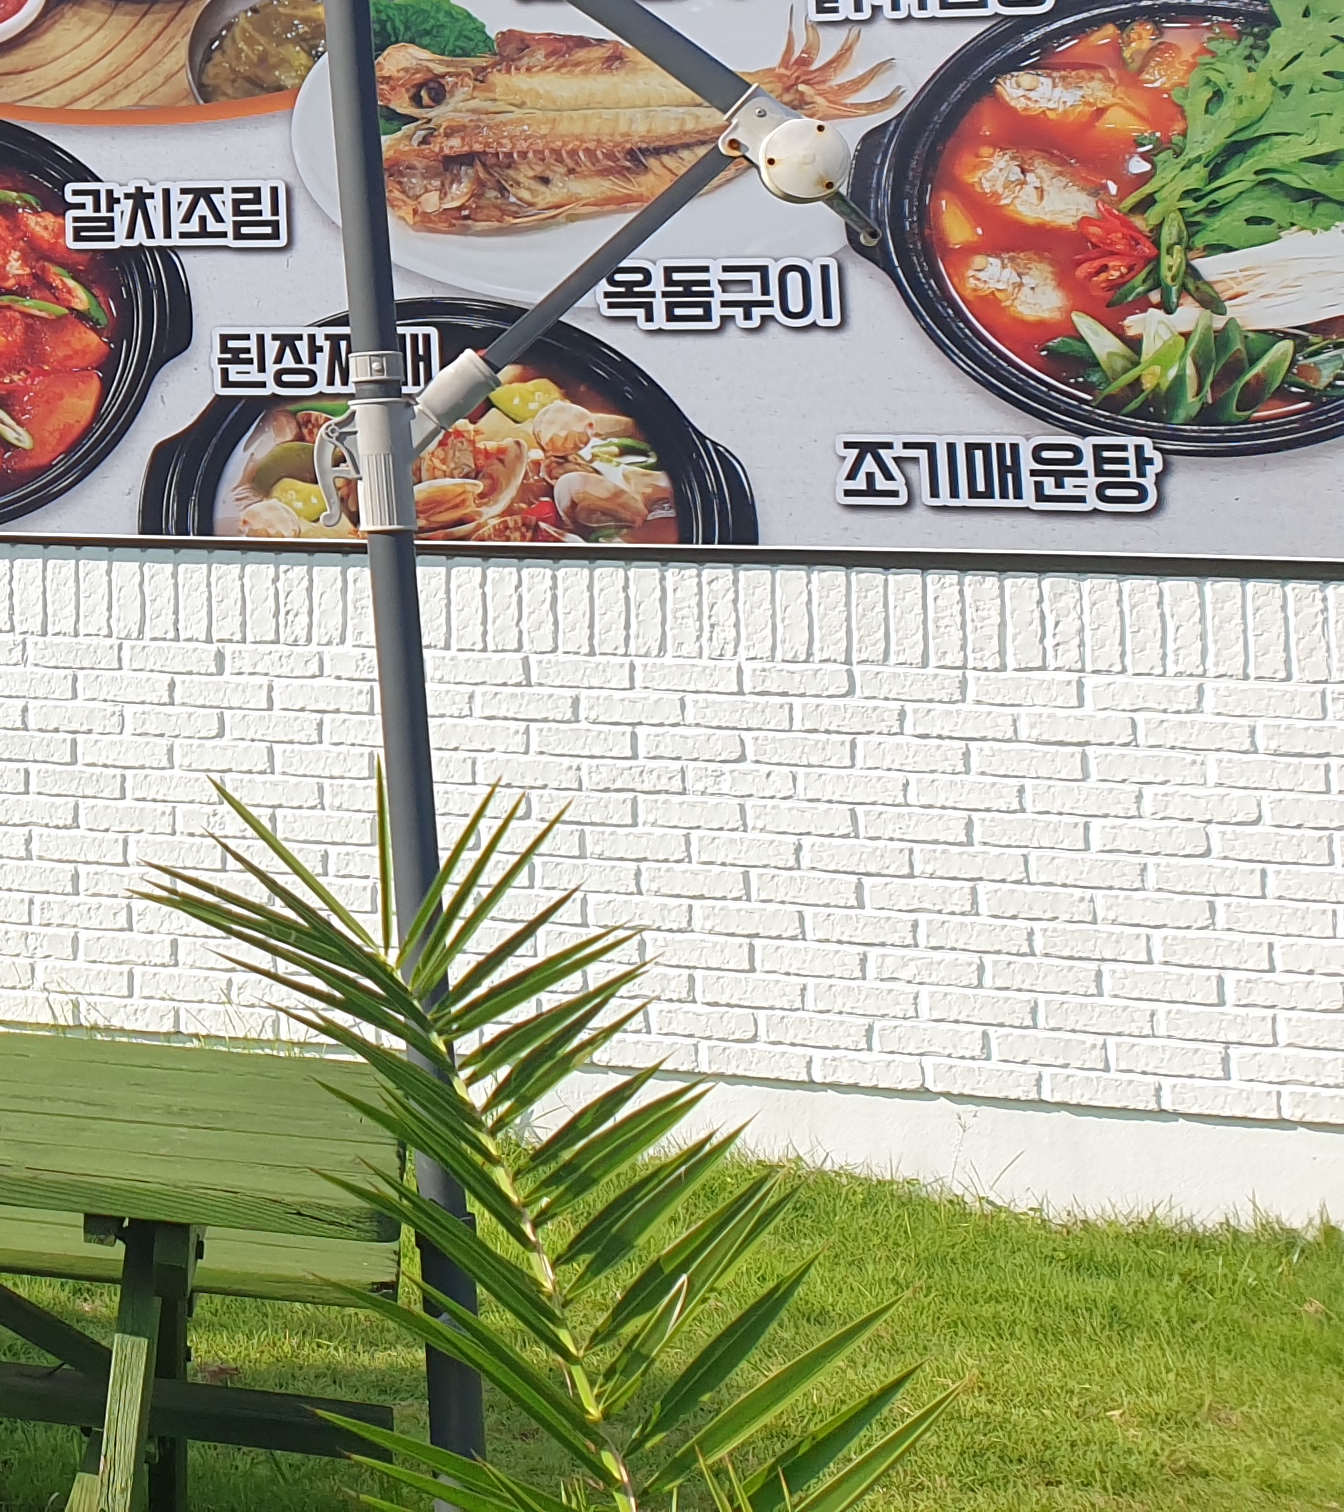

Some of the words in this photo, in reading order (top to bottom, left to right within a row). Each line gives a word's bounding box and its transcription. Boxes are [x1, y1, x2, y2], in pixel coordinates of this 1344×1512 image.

[71, 185, 282, 243] 갈치조림
[603, 263, 833, 324] 옥돔구이
[843, 441, 1155, 505] 조기매운탕
